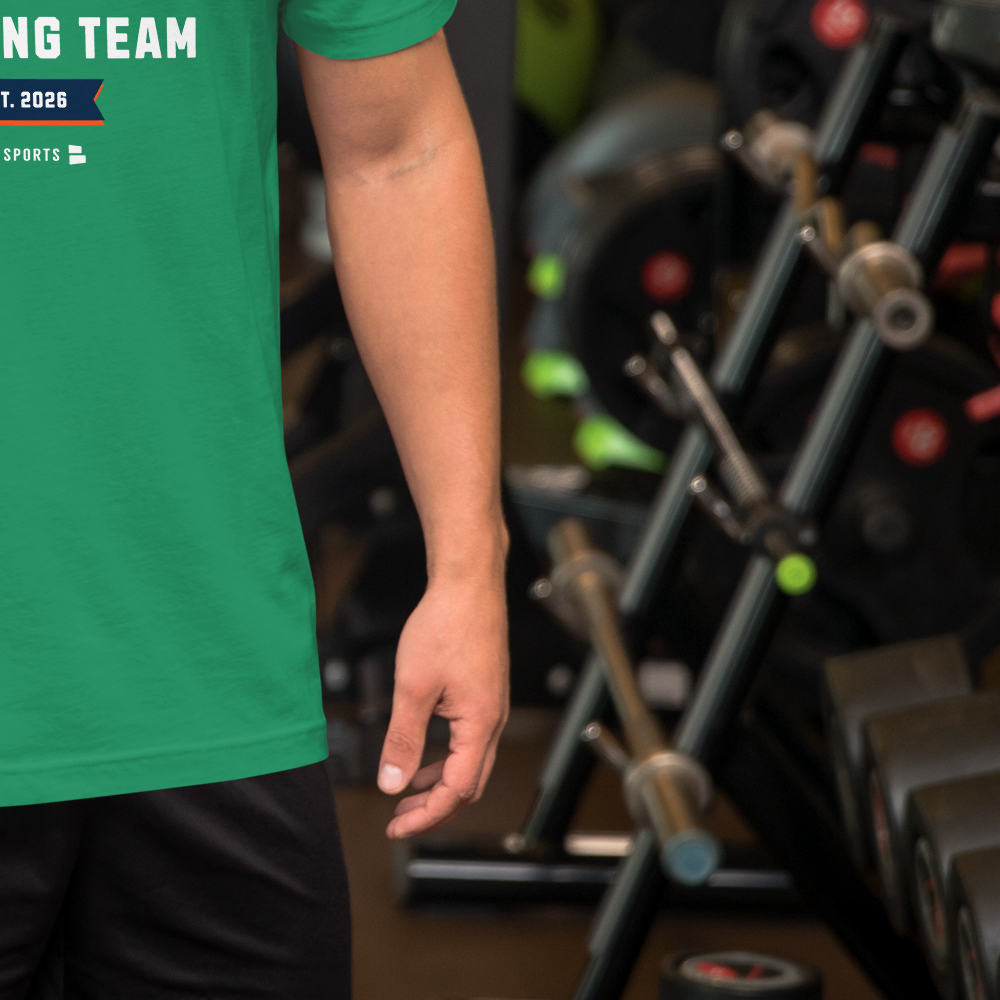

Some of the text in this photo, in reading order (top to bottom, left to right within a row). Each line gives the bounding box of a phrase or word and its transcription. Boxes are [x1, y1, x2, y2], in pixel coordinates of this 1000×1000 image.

[78, 16, 197, 59] TEAM
[20, 91, 67, 108] 2026
[3, 147, 60, 162] SPORTS
